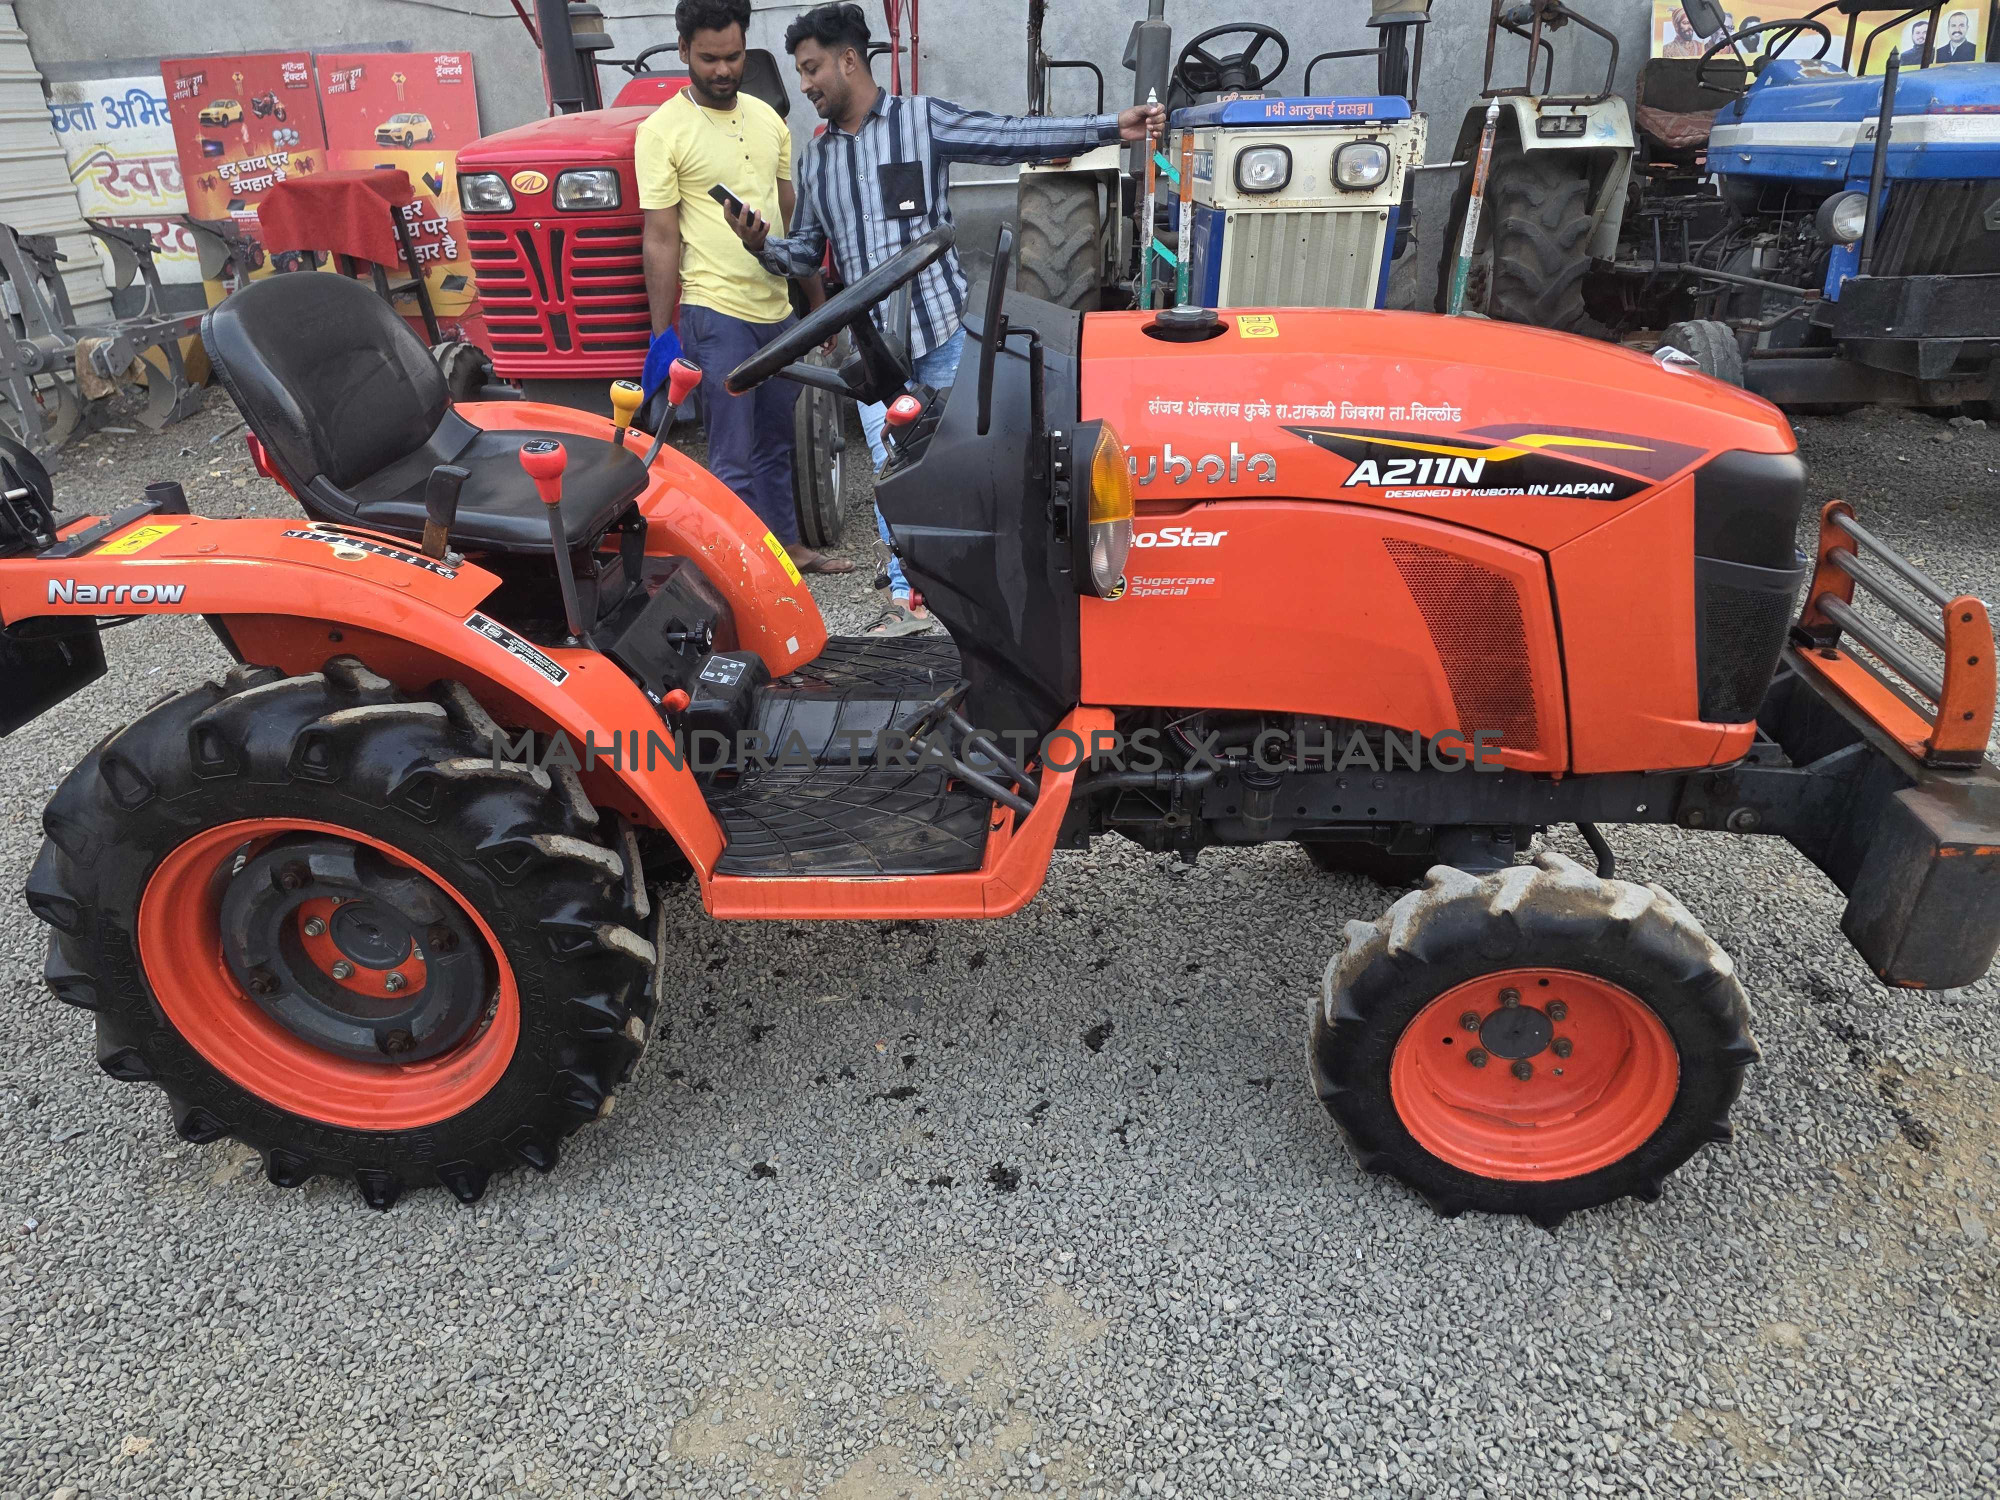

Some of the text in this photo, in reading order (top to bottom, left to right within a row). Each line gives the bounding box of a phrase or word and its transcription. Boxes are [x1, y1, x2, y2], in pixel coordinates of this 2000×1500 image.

[217, 151, 289, 179] हर चाय पर
[230, 174, 274, 195] उपहार
[402, 200, 423, 220] हर
[422, 217, 448, 235] पर
[441, 234, 458, 259] है
[1149, 396, 1183, 415] संजय
[1187, 396, 1240, 417] शंकरराव
[1244, 399, 1271, 421] फुके
[1340, 401, 1385, 420] जिवरग
[1122, 441, 1277, 485] ubota
[1345, 457, 1486, 486] A211N
[1385, 482, 1614, 499] DESIGNED BY KUBOTA IN JAPAN
[48, 579, 185, 604] Narrow
[1131, 576, 1215, 587] Sugarcane
[1131, 586, 1189, 598] Special
